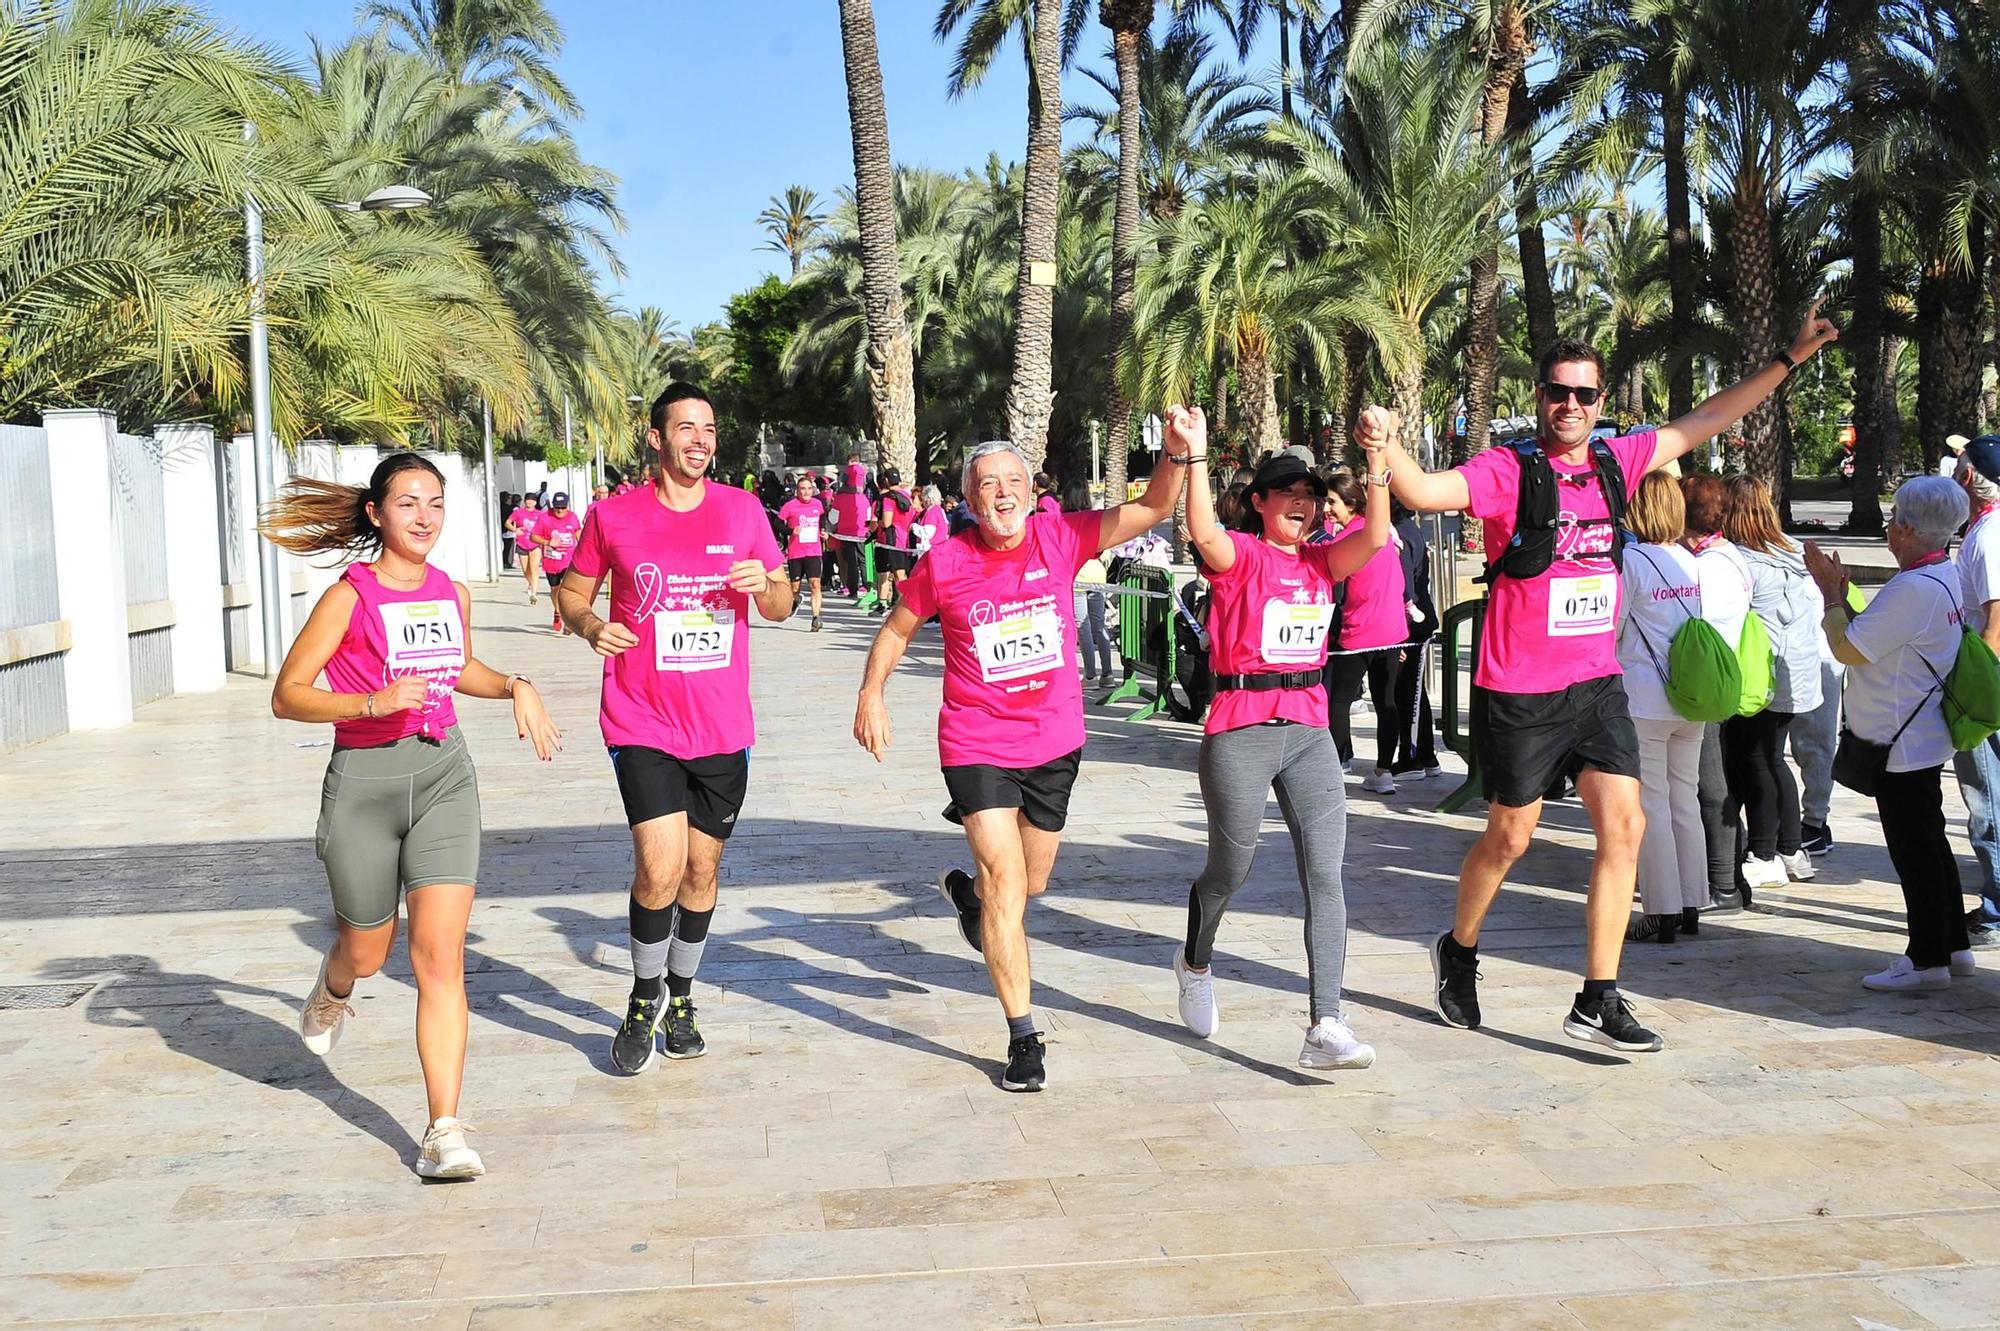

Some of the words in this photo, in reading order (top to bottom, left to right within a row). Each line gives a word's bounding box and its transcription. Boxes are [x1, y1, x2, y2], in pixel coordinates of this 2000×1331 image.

[1565, 595, 1608, 616] 0749
[403, 622, 452, 646] 0751
[671, 631, 721, 652] 0752
[993, 634, 1045, 662] 0753
